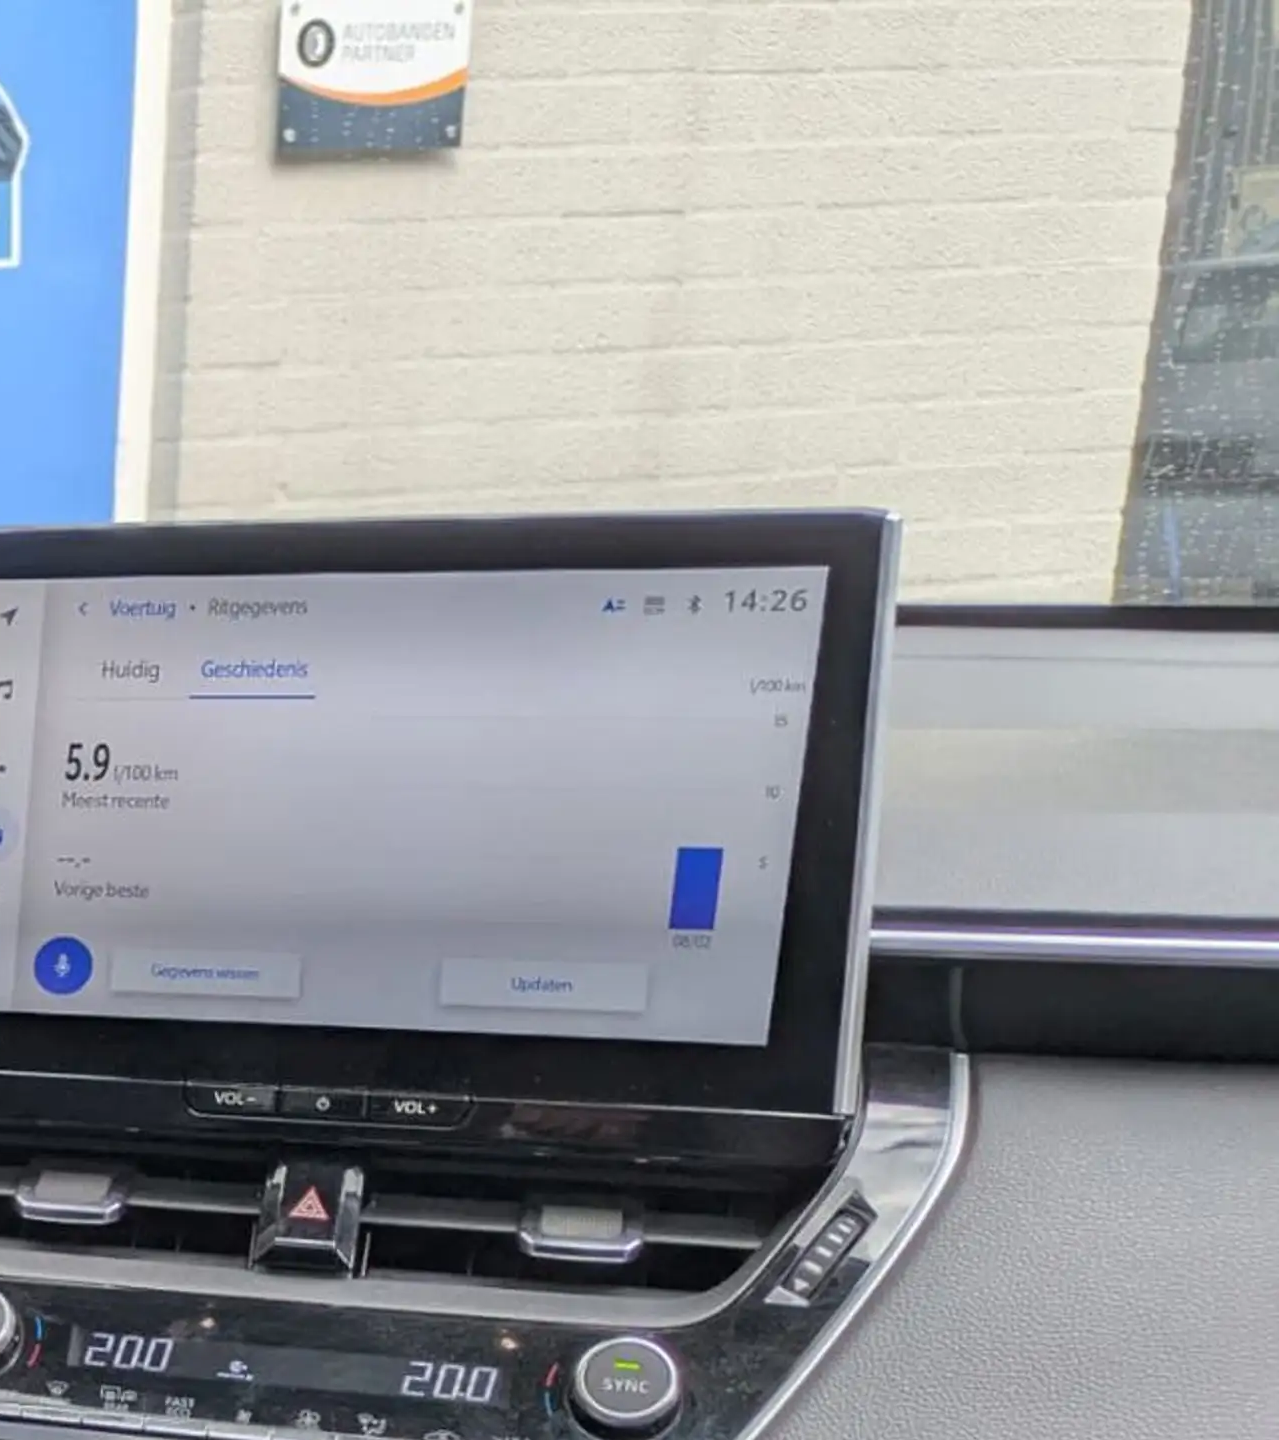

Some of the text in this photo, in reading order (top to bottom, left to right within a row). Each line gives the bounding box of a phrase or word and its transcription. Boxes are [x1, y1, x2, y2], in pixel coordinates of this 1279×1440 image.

[109, 598, 308, 619] Voertuig Ritgegevens
[725, 588, 808, 613] 14:26
[102, 659, 308, 681] Huidig Geschiedenis
[65, 743, 111, 782] 5.9
[61, 792, 108, 808] Meest
[54, 879, 150, 899] Vorige beste
[602, 1376, 650, 1394] SYNC
